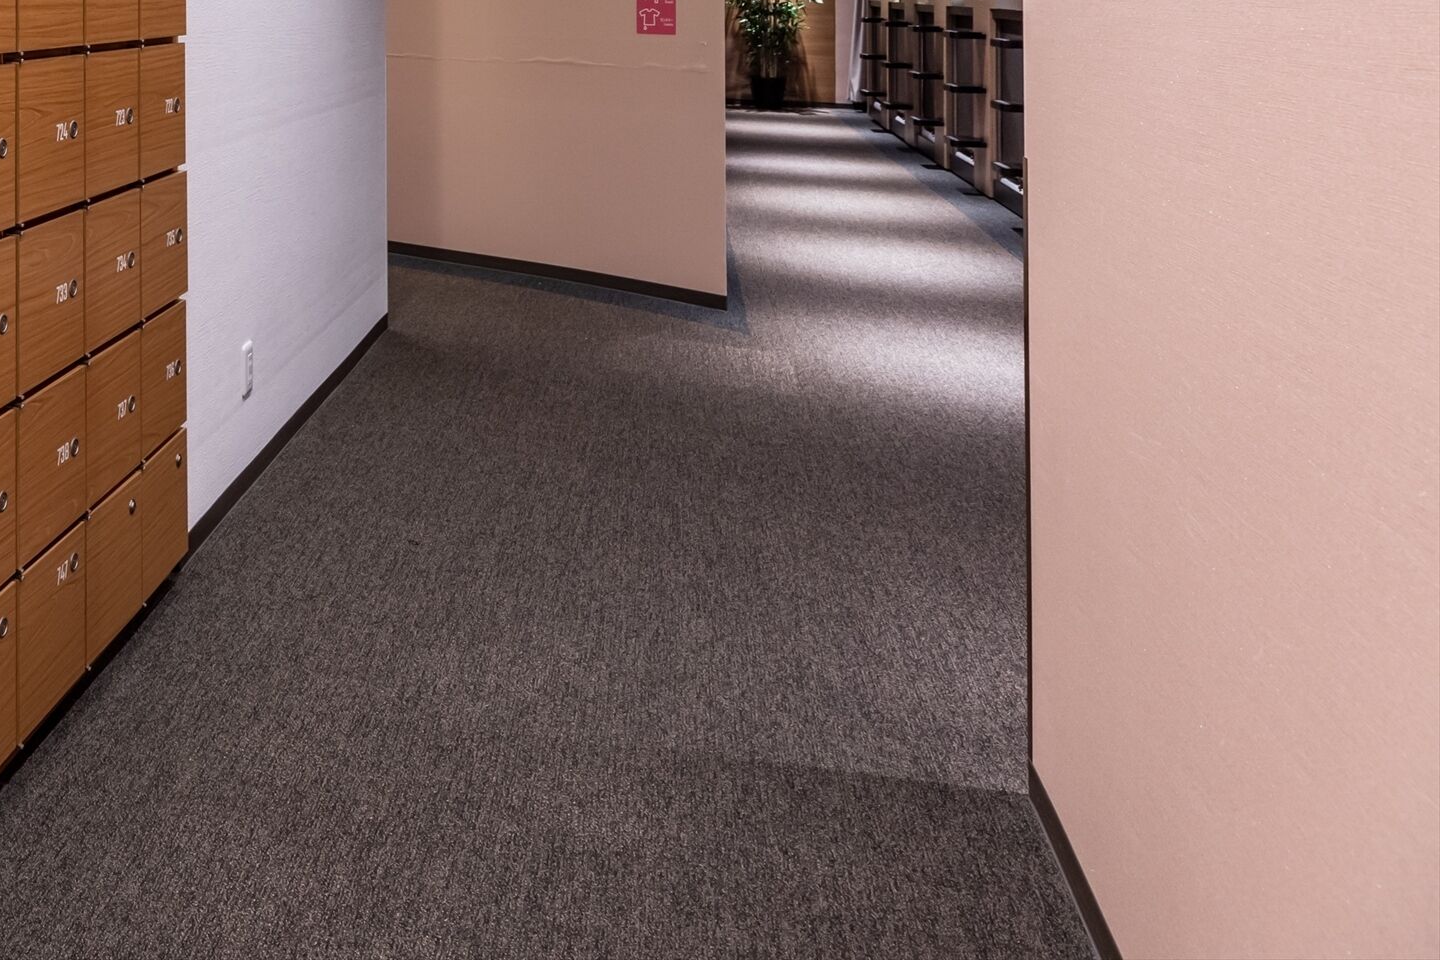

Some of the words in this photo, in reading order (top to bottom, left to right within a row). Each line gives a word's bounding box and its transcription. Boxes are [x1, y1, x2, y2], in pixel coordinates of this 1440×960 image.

[55, 122, 69, 142] 724
[55, 282, 68, 304] 733
[56, 444, 70, 466] 738
